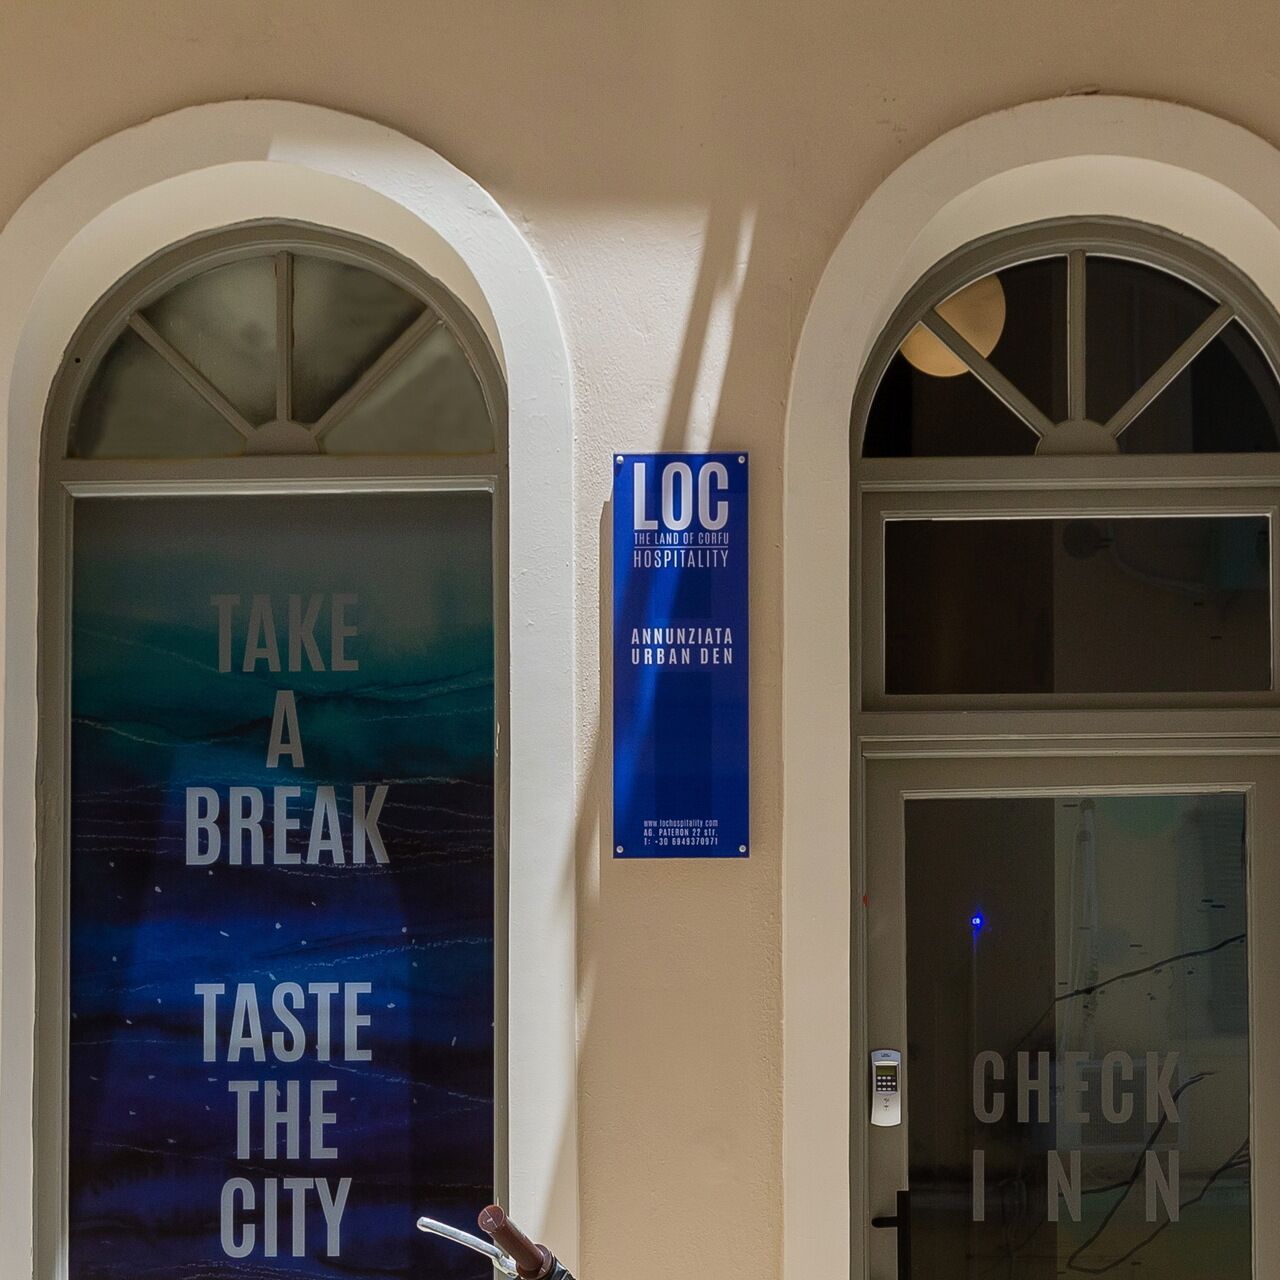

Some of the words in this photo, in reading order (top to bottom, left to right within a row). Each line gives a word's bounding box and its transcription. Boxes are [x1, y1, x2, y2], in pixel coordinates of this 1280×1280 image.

[633, 461, 729, 531] LOC
[633, 549, 729, 568] HOSPITALITY
[634, 532, 651, 545] THE
[654, 532, 679, 545] LAND
[683, 532, 694, 545] OF
[698, 532, 729, 545] CORFU
[211, 593, 360, 674] TAKE
[631, 627, 733, 645] ANNUNZIATA
[631, 647, 691, 665] URBAN
[700, 647, 733, 665] DEN
[265, 689, 306, 769] A
[184, 786, 391, 866] BREAK
[692, 828, 701, 837] 22
[194, 982, 373, 1063] TASTE
[228, 1080, 338, 1160] THE
[972, 1050, 1181, 1124] CHECK
[220, 1177, 352, 1258] CITY
